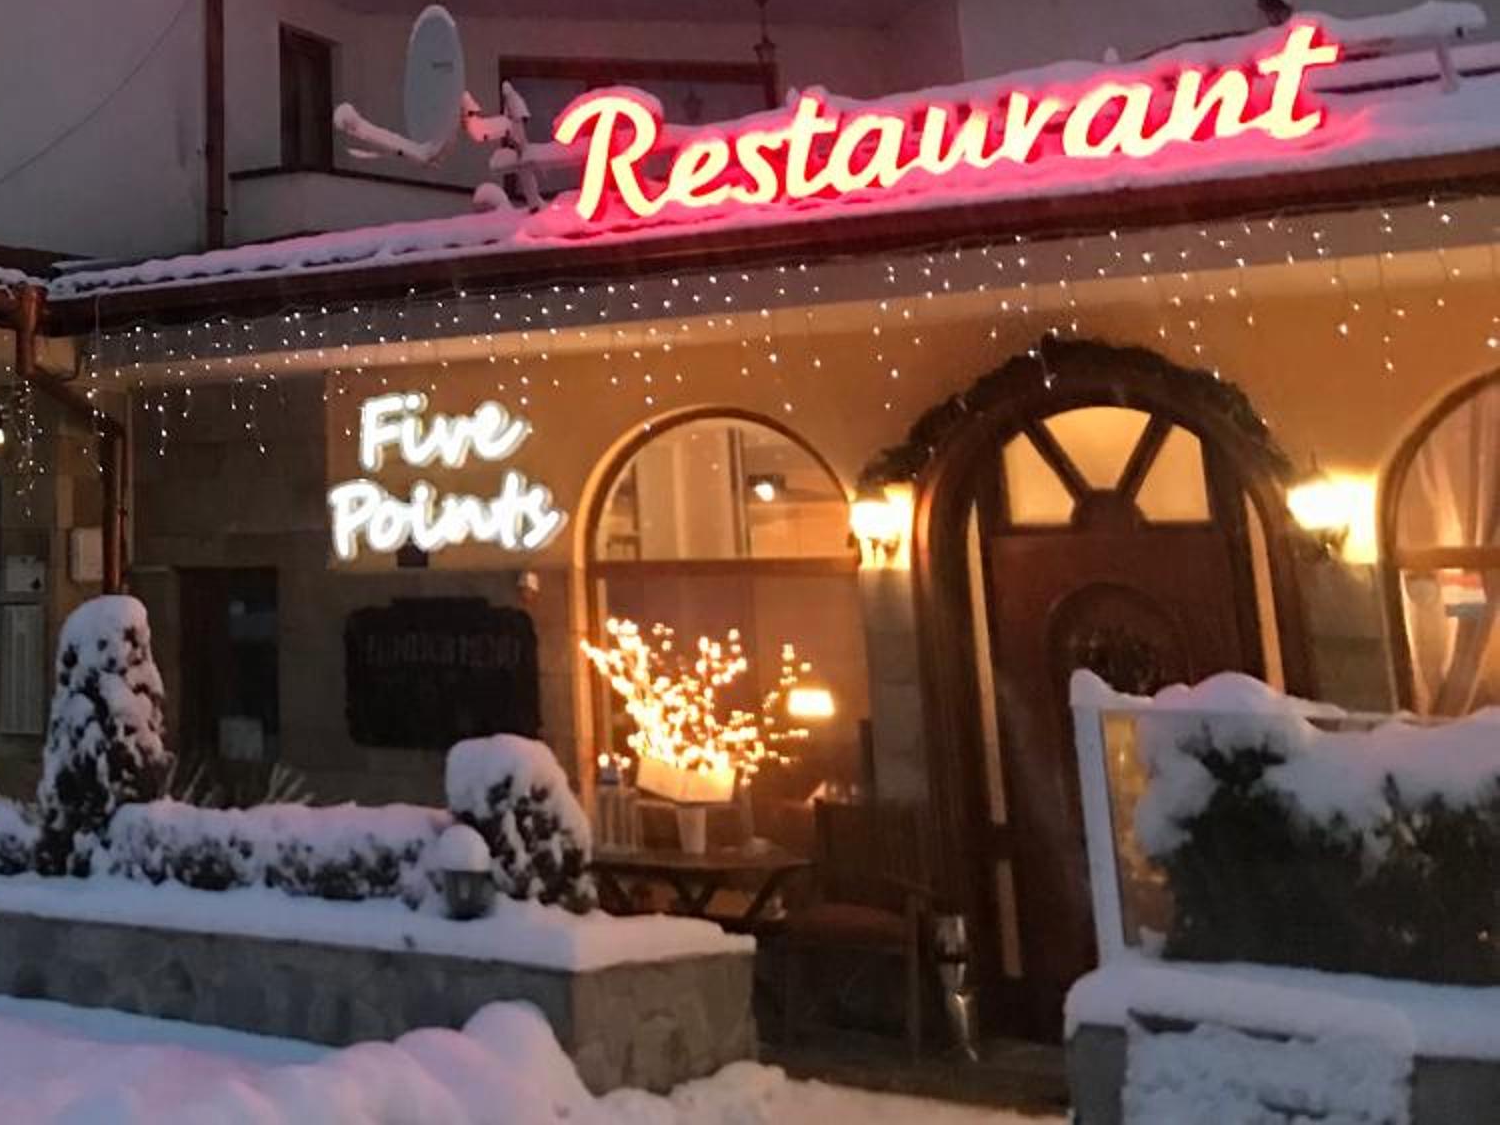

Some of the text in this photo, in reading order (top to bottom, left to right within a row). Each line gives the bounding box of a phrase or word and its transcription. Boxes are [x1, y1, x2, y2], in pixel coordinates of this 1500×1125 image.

[555, 24, 1339, 221] Restaurant
[360, 394, 526, 469] Five
[329, 472, 564, 559] Points
